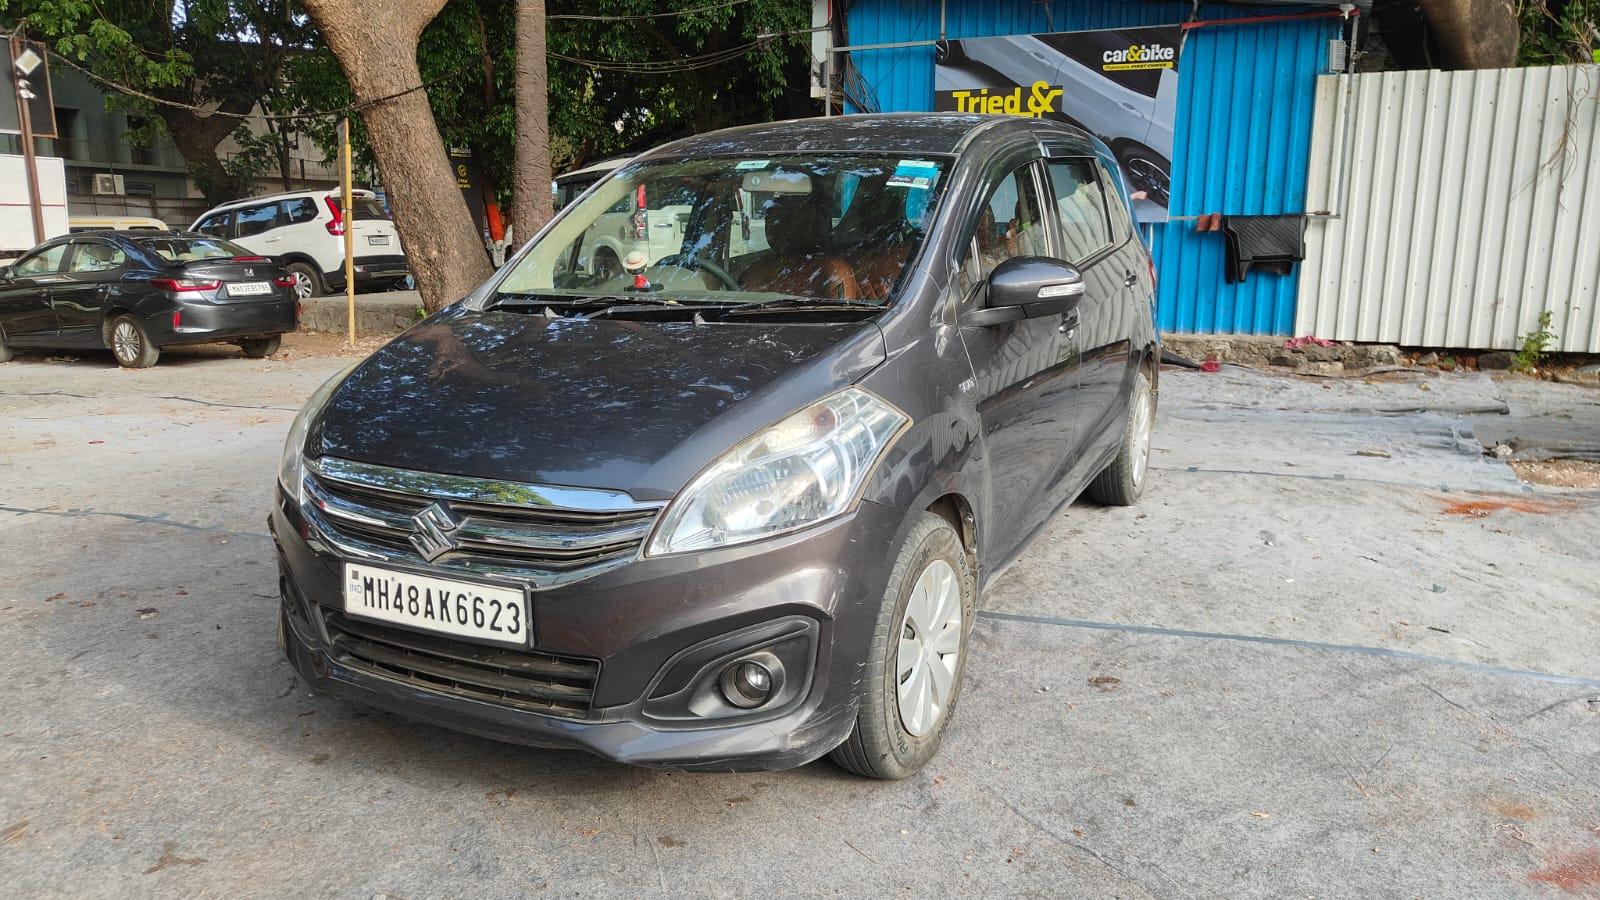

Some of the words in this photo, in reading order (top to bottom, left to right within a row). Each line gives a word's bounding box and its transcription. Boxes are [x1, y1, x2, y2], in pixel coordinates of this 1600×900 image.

[1103, 44, 1174, 63] car&bike
[953, 87, 1021, 113] Tried
[1028, 81, 1064, 113] &
[363, 576, 520, 634] MH48AK6623
